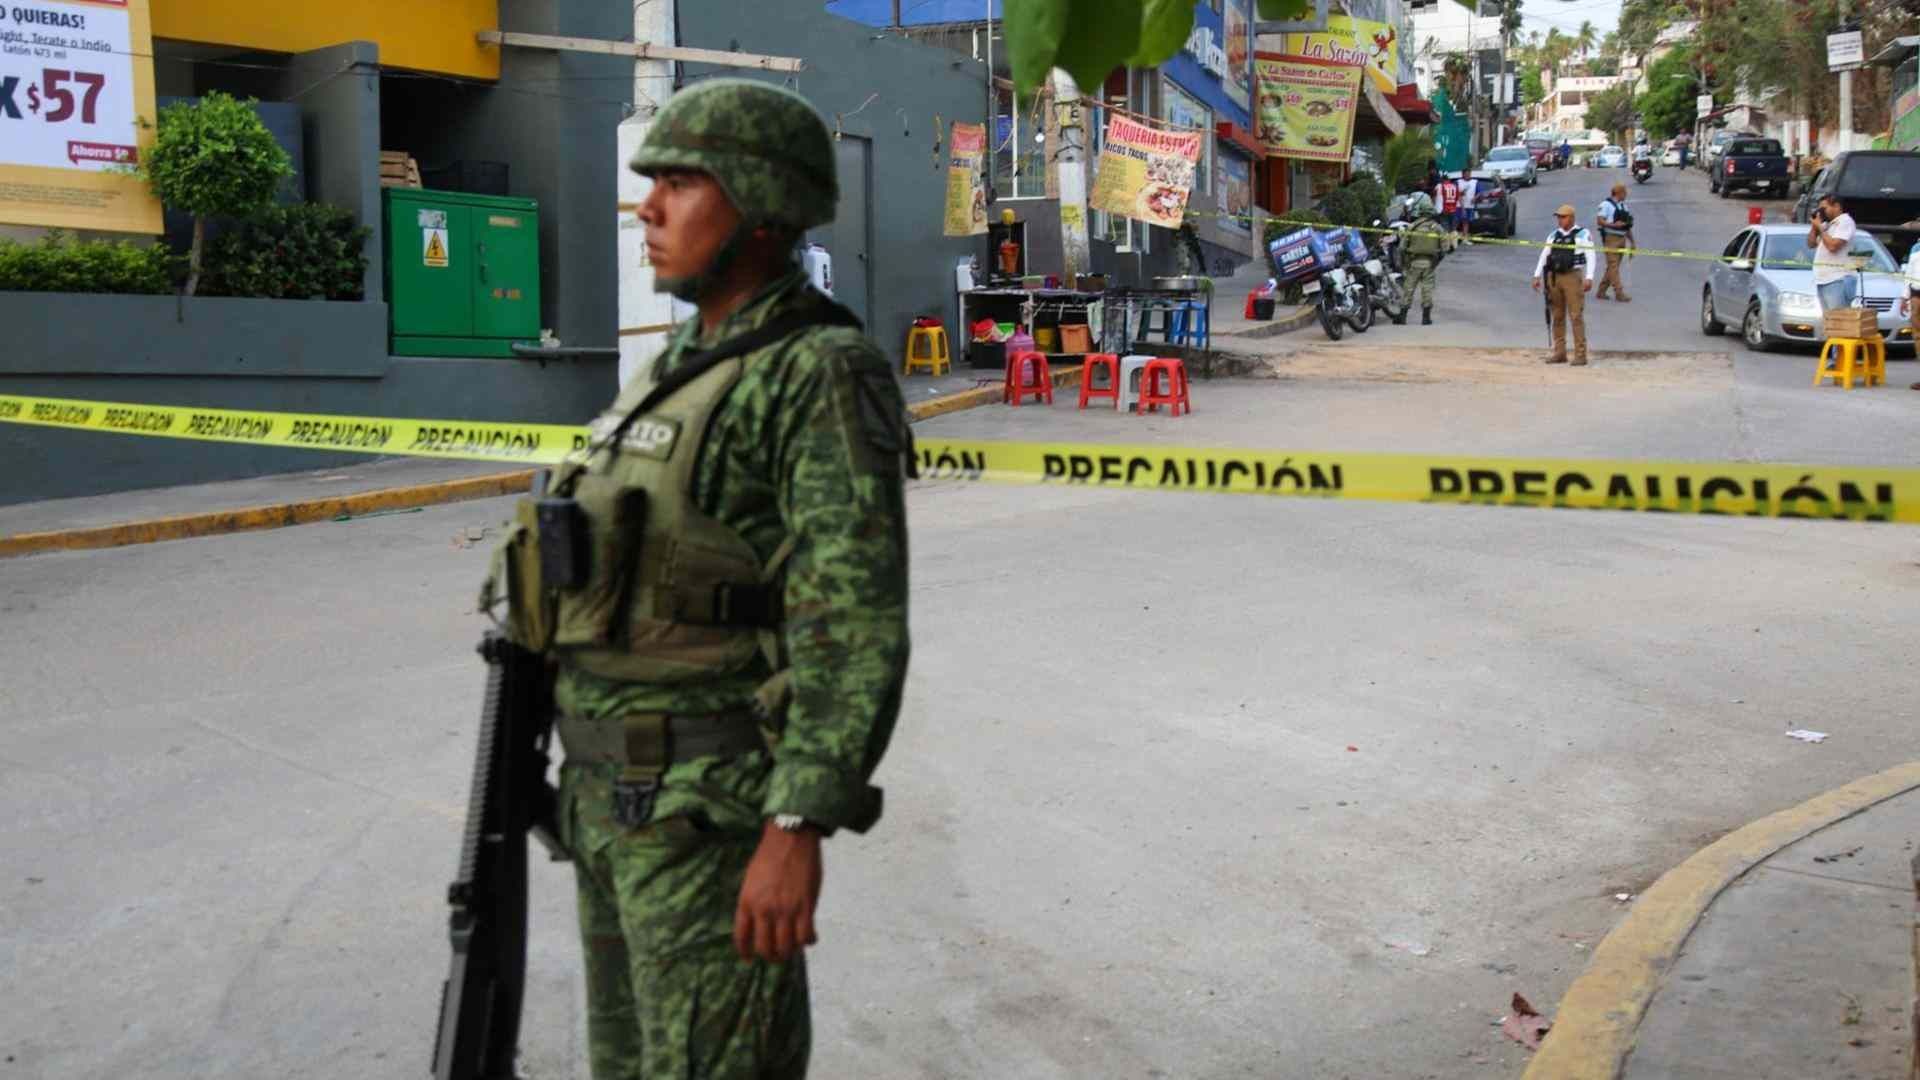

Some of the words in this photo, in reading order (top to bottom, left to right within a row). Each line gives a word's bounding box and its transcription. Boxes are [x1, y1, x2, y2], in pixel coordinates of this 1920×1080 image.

[13, 7, 85, 30] QUIERAS!
[1301, 35, 1323, 58] La
[1428, 467, 1894, 521] PRECAUCIÓN
